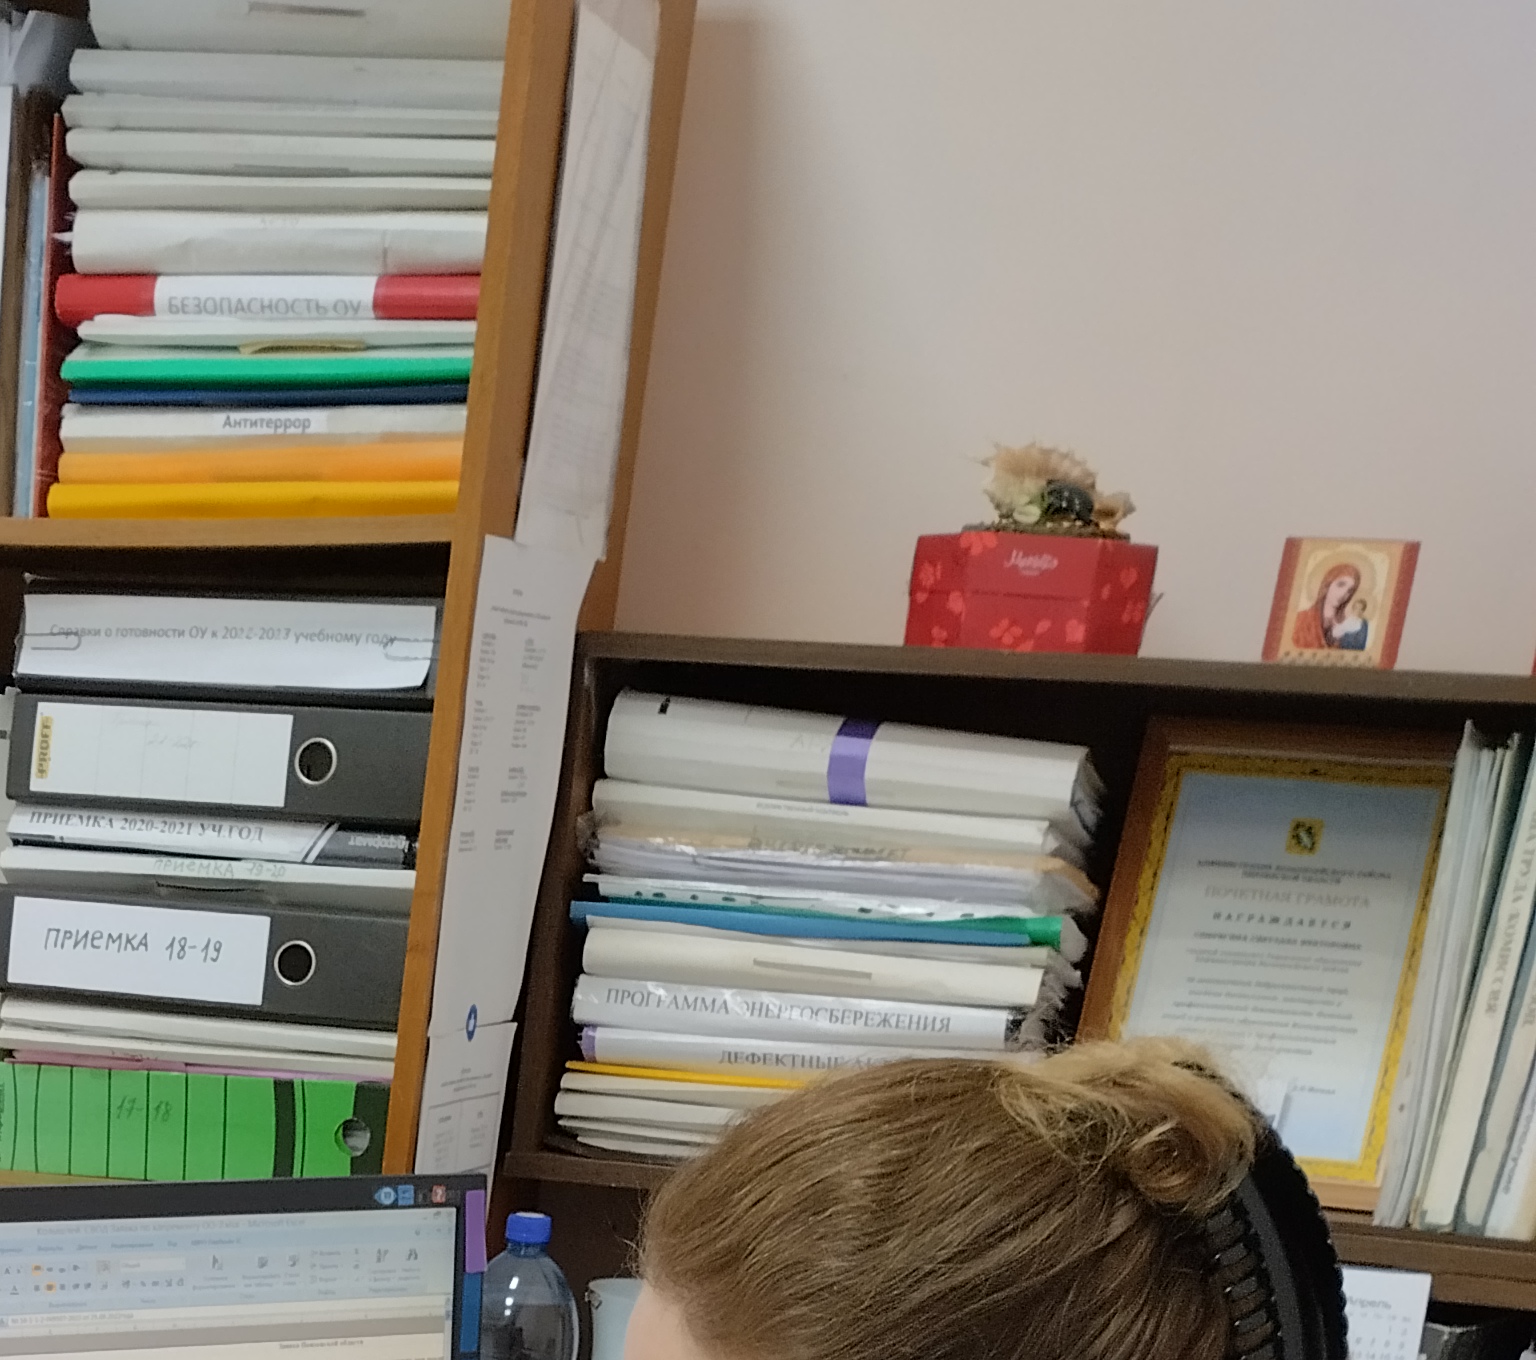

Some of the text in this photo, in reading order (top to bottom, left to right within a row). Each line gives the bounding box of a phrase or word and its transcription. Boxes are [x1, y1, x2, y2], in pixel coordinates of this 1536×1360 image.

[167, 295, 329, 317] БЕЗОПАСНОСТЬ
[222, 414, 312, 434] Антитеррор
[114, 628, 186, 640] готовности
[188, 627, 208, 640] ОУ
[294, 628, 363, 646] учебному
[27, 809, 265, 844] ПРИЕМКА 2020-2021 УЧ.ГОД
[164, 935, 223, 963] 18-19
[606, 987, 731, 1017] ПРОГРАММА
